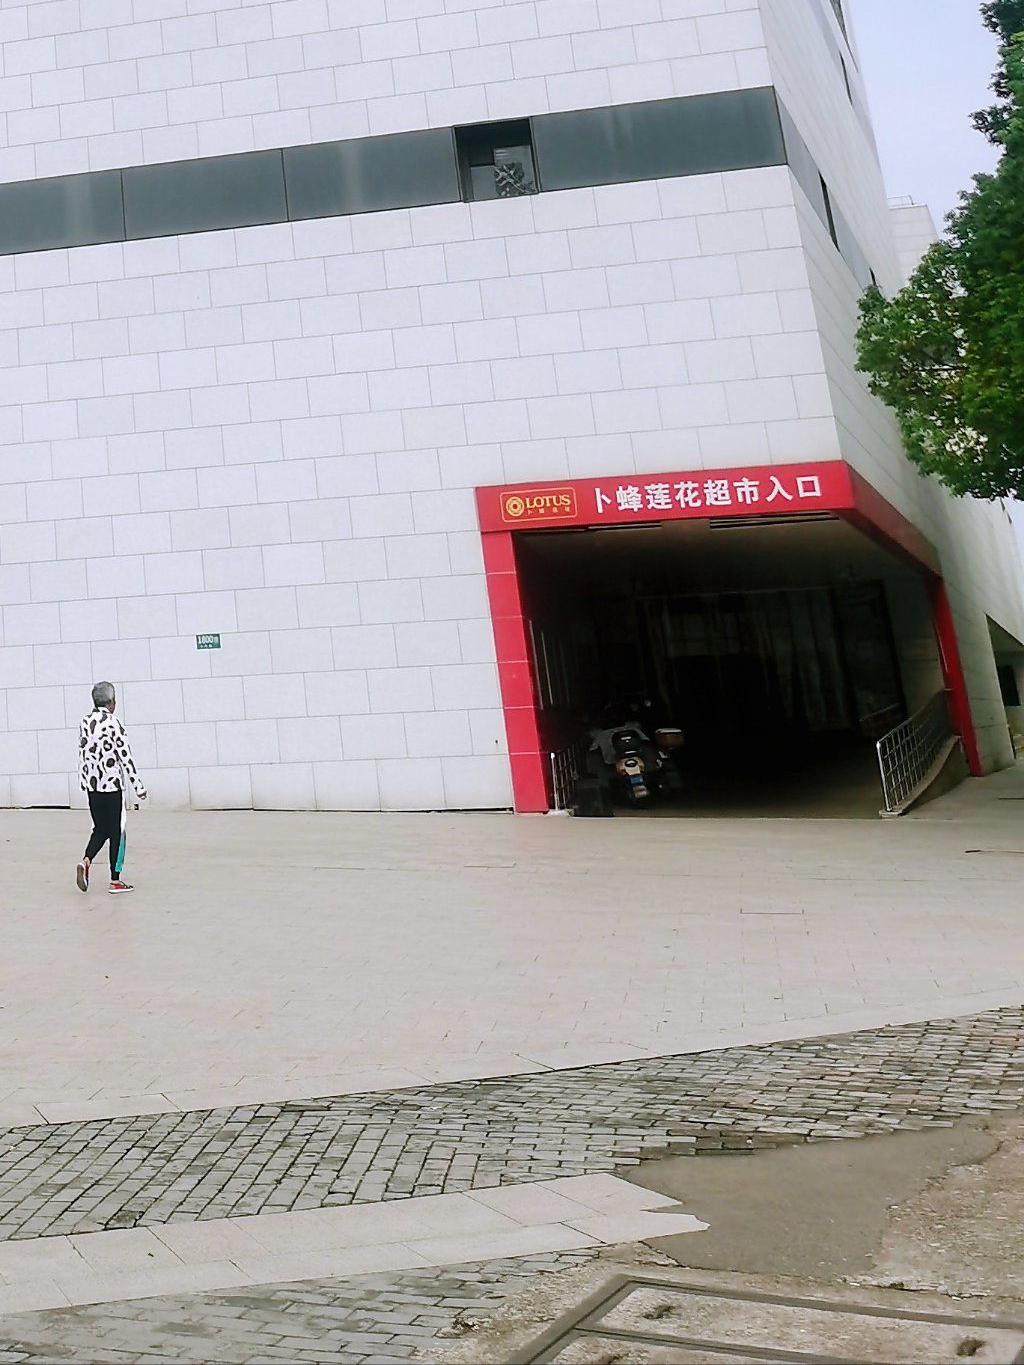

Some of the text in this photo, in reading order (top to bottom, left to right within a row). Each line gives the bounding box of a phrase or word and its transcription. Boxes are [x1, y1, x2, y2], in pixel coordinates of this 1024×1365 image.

[525, 494, 571, 509] LOTUS
[593, 475, 822, 514] 卜蜂莲花超市入口
